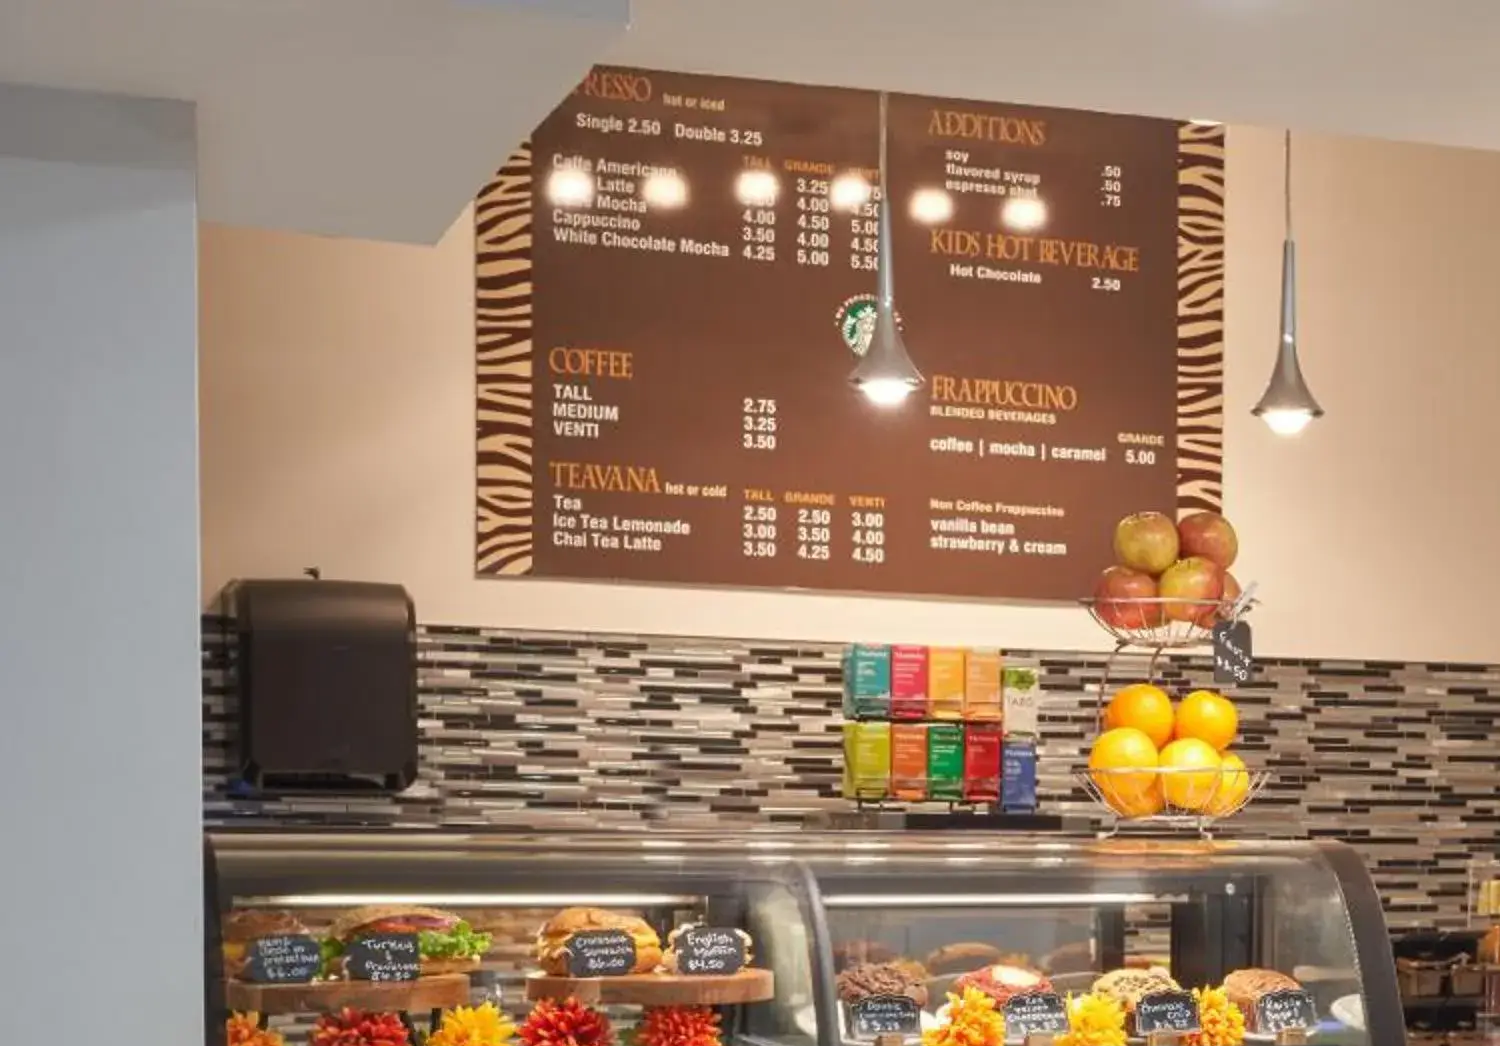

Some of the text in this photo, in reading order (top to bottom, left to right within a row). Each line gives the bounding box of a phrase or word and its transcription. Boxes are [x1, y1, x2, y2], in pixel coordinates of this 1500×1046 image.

[583, 72, 651, 101] RESSO
[686, 97, 697, 108] or
[701, 97, 725, 111] iced
[576, 112, 762, 146] Single 2.50 Double 3.25
[928, 109, 1046, 146] ADDITIONS
[597, 158, 677, 177] Americano
[797, 178, 828, 194] 3.25
[945, 149, 1121, 178] soy .50
[945, 163, 1121, 192] flavored syrup .50
[598, 178, 828, 212] Latte 4.00
[945, 179, 1006, 196] espresso
[1101, 194, 1121, 207] .75
[552, 208, 641, 231] Cappuccino
[743, 227, 775, 242] 3.50
[797, 232, 829, 248] 4.00
[598, 196, 647, 214] Mocha
[743, 210, 775, 225] 4.00
[797, 214, 829, 230] 4.50
[553, 228, 597, 248] White
[602, 232, 676, 253] Chocolate
[681, 239, 730, 257] Mocha
[743, 246, 775, 261] 4.25
[797, 250, 829, 266] 5.00
[929, 228, 1139, 272] KIDS HOT BEVERAGE
[950, 263, 1121, 291] Hot Chocolate 2.50
[549, 346, 633, 380] COFFEE
[553, 383, 776, 414] TALL 2.75
[931, 376, 1077, 410] FRAPPUCCINO
[553, 402, 776, 432] MEDIUM 3.25
[930, 407, 1056, 425] BLENDED BEVERAGES
[553, 420, 776, 450] VENTI 3.50
[930, 436, 1155, 465] coffee mocha caramel 5.00
[1118, 432, 1164, 447] GRANDE
[549, 461, 727, 498] TEAVANA hot or cold
[553, 495, 582, 511] Tea
[744, 506, 776, 521] 2.50
[851, 512, 883, 528] 3.00
[930, 497, 953, 511] Non
[956, 499, 992, 514] Coffee
[553, 513, 885, 546] Ice Tea Lemonade 3.00 3.50 4.00
[930, 517, 1015, 535] vanilla bean
[553, 531, 885, 563] Chai Tea Latte 3.50 4.25 4.50
[930, 534, 1067, 556] strawberry & cream
[687, 932, 733, 948] English
